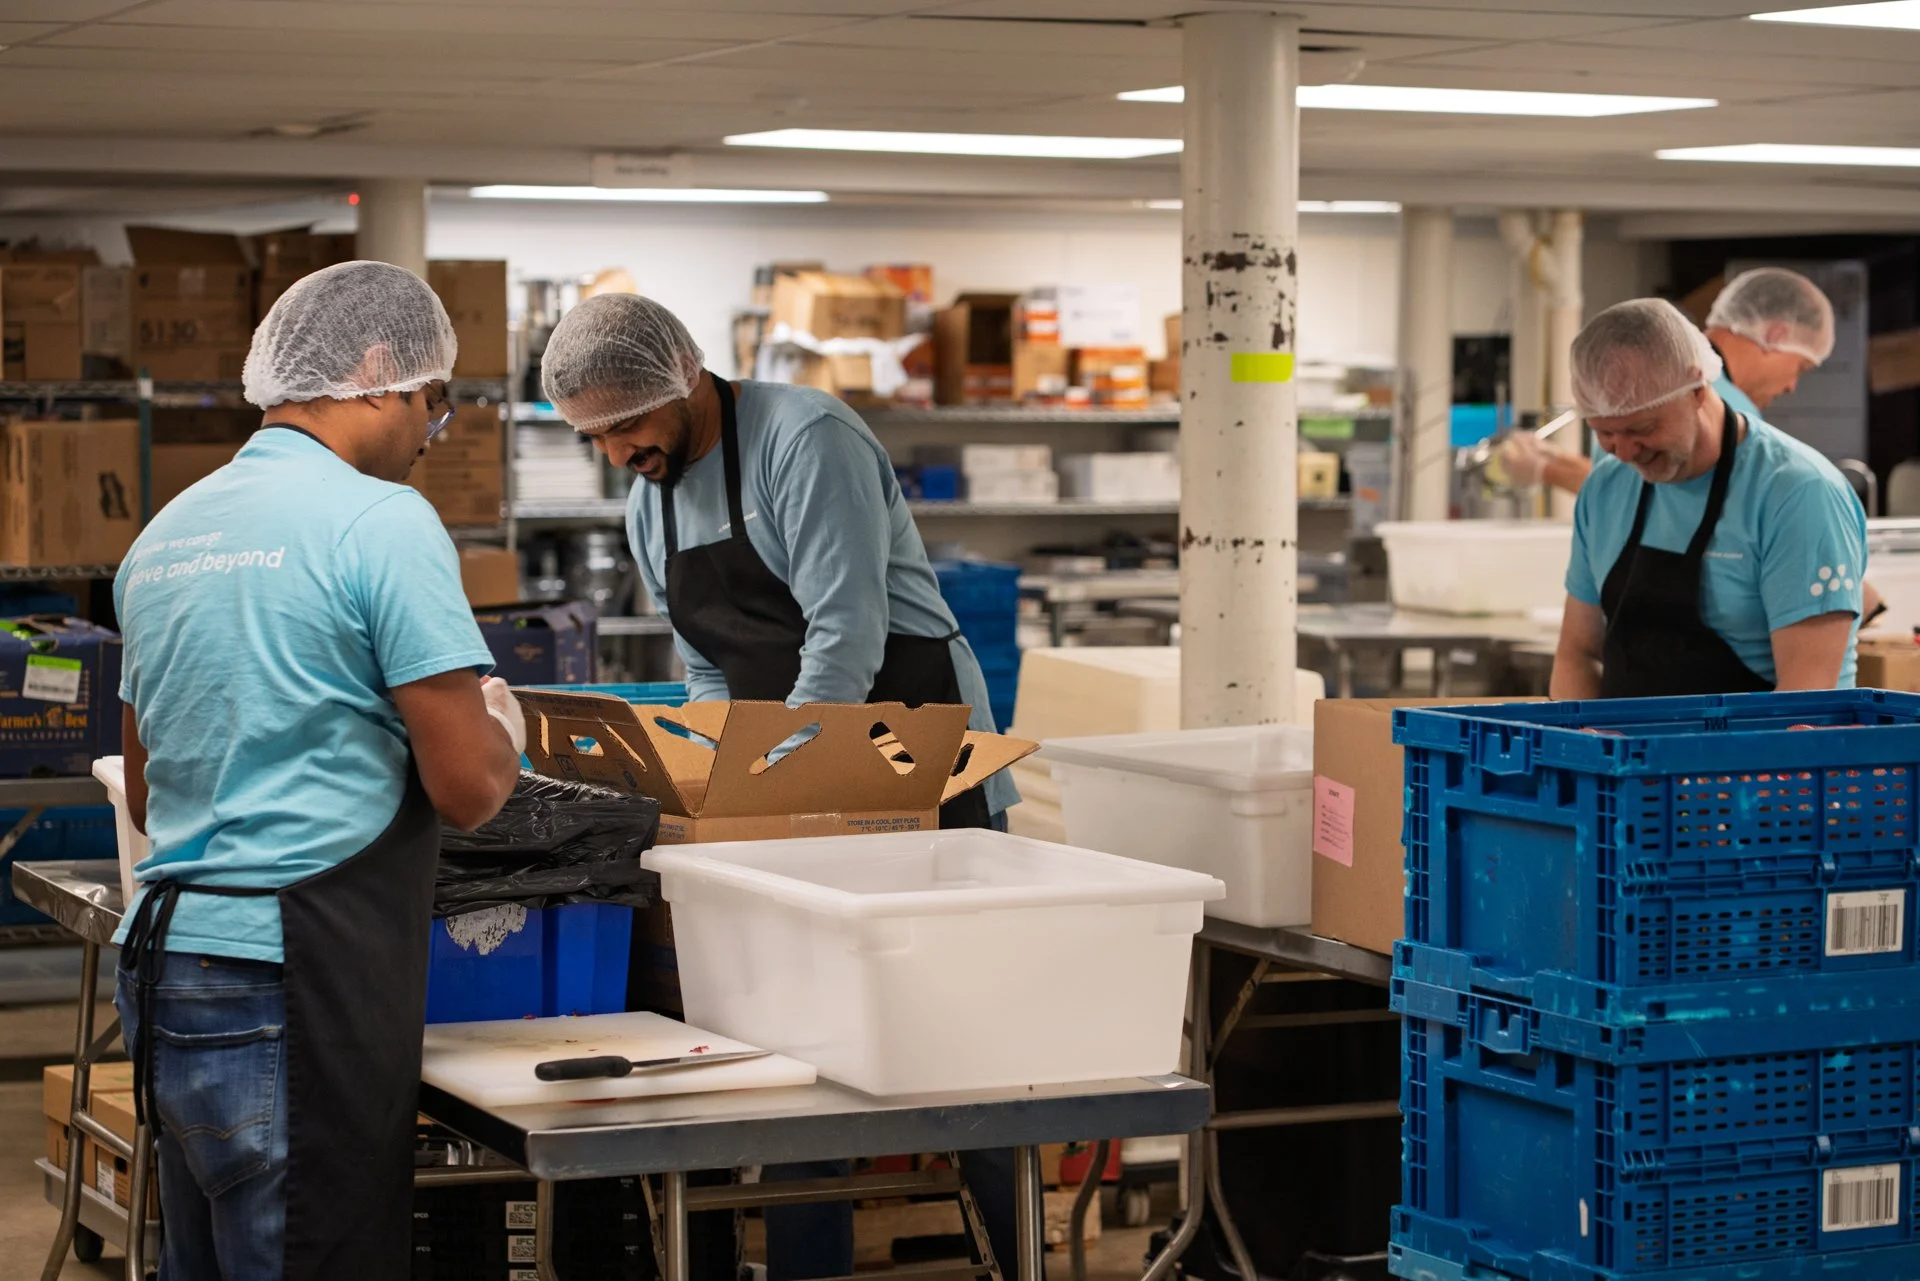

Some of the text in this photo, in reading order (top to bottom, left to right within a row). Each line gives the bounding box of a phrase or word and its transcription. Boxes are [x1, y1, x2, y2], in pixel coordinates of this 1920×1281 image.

[166, 552, 202, 578] and
[202, 546, 286, 574] beyond
[0, 711, 41, 729] armer's
